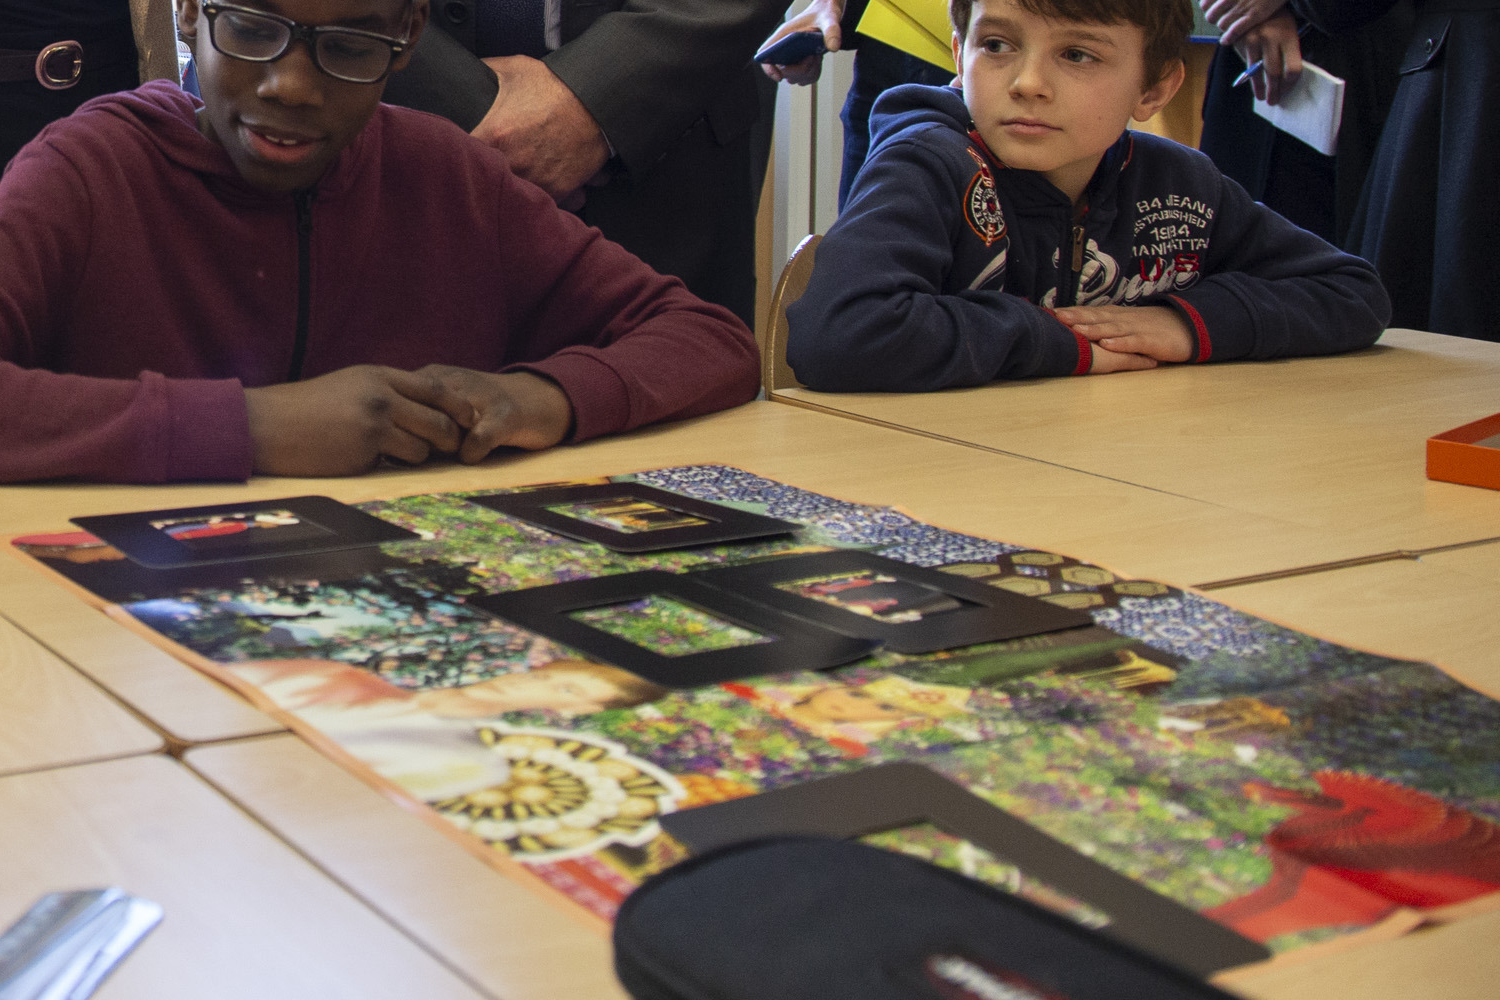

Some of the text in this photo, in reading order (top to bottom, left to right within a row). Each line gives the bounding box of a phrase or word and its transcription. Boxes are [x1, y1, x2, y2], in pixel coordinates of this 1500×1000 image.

[1136, 194, 1214, 219] 84 JEANS
[1150, 224, 1191, 241] 1984
